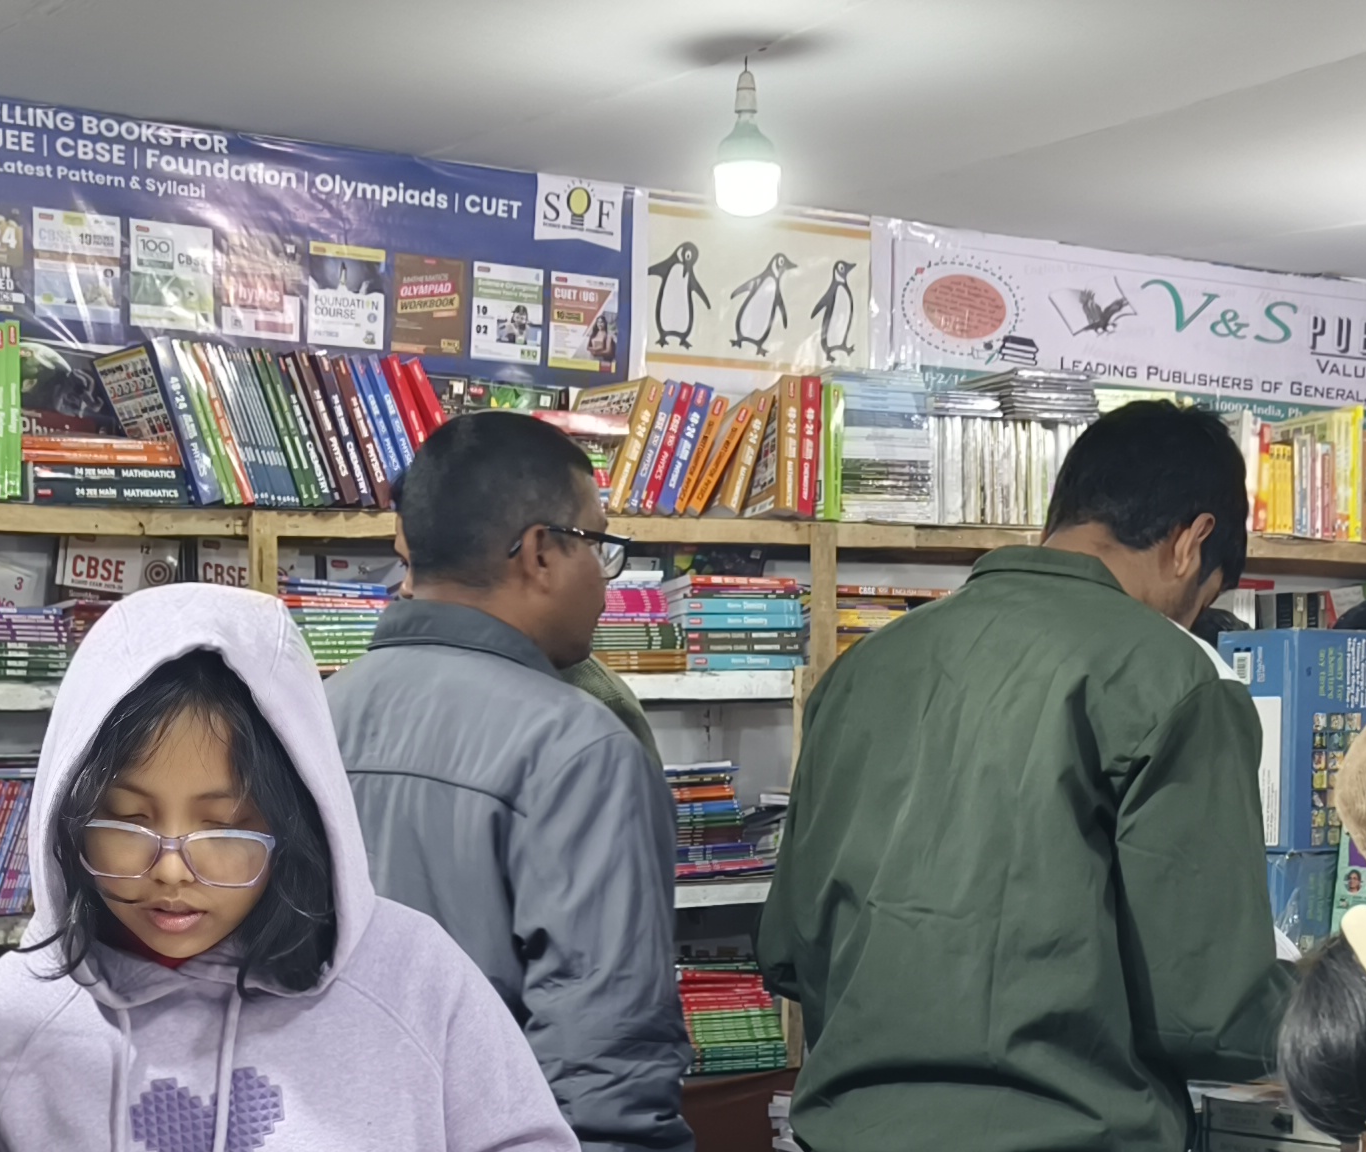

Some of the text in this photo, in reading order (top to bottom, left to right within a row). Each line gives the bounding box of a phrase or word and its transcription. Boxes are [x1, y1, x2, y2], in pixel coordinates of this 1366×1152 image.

[82, 115, 173, 146] BOOKS
[181, 132, 227, 154] FOR
[56, 137, 126, 166] CBSE
[146, 150, 297, 189] Foundation
[315, 174, 449, 210] Olympiads
[465, 194, 522, 219] CUET
[57, 165, 125, 189] Pattern
[129, 176, 142, 190] &
[145, 177, 207, 200] Syllabi
[398, 297, 456, 312] WORKBOOK
[400, 282, 452, 298] OLYMPIAD
[554, 288, 578, 301] CUET
[314, 306, 356, 320] COURSE
[1060, 356, 1137, 380] LEADING
[1146, 364, 1254, 392] PUBLISHERS
[1261, 379, 1283, 393] OF
[306, 441, 330, 494] CHEMISTRY
[329, 436, 349, 478] PHYSICS
[346, 441, 368, 495] CHEMISTRY
[366, 443, 385, 484] PHYSICS
[121, 469, 176, 480] MATHEMATICS
[123, 488, 179, 499] MATHEMATICS
[72, 554, 125, 583] CBSE
[203, 562, 247, 586] CBSE
[14, 577, 23, 590] 3
